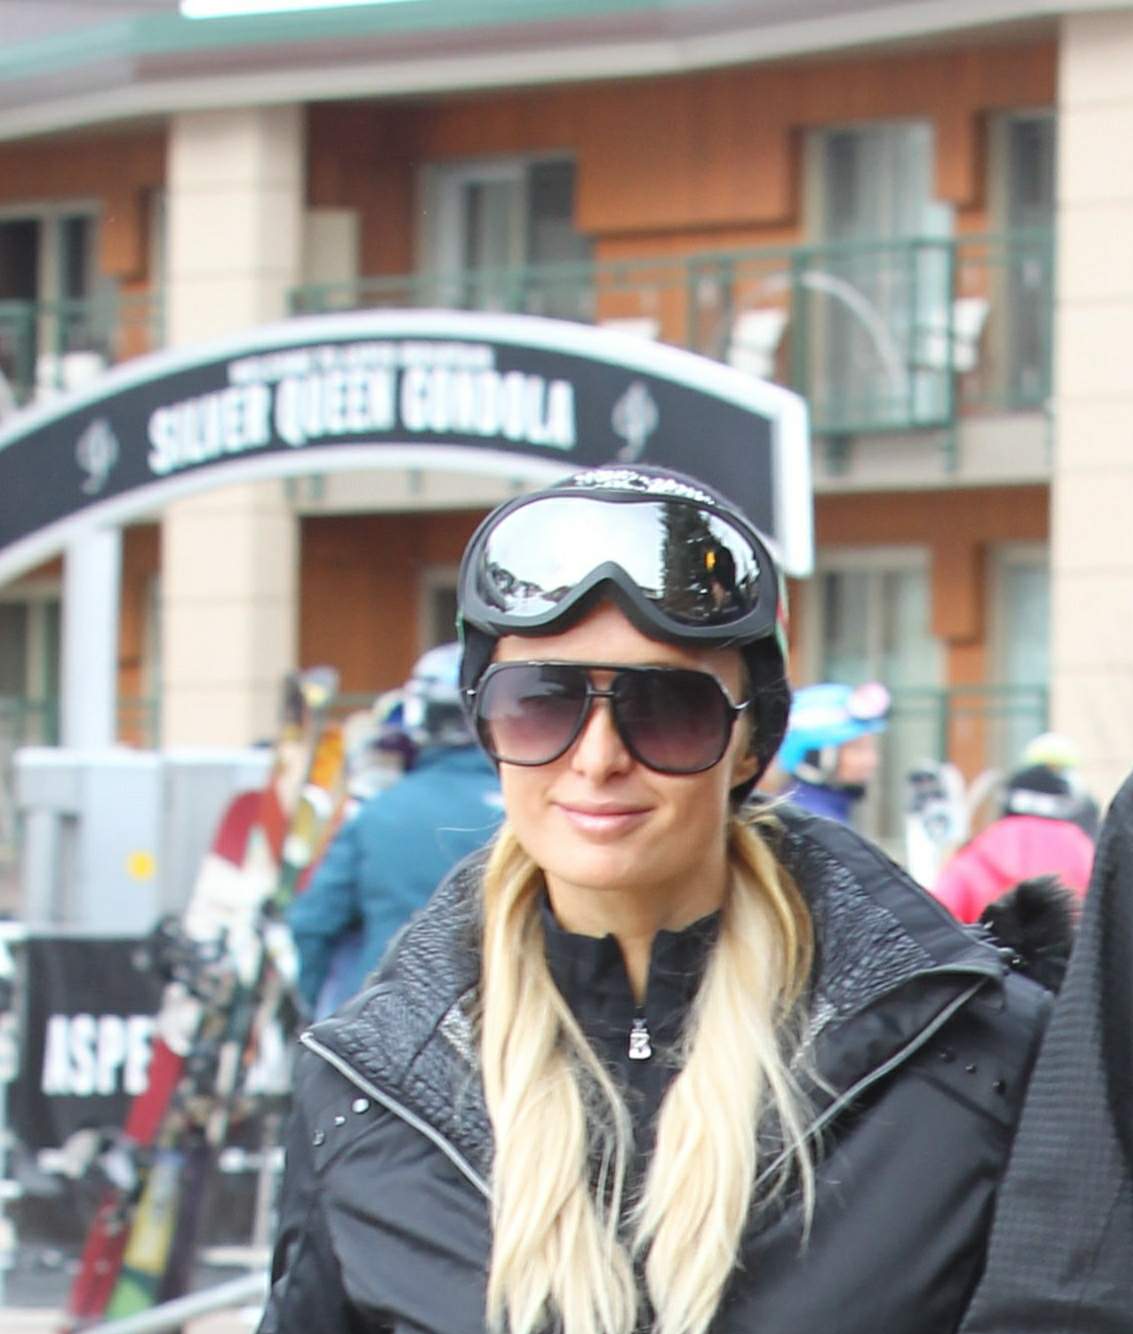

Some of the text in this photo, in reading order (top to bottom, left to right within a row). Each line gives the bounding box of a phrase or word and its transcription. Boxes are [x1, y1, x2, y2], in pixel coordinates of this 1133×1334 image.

[148, 368, 577, 475] SILVER QUEEN GONDOLA
[41, 1014, 155, 1096] ASPE
